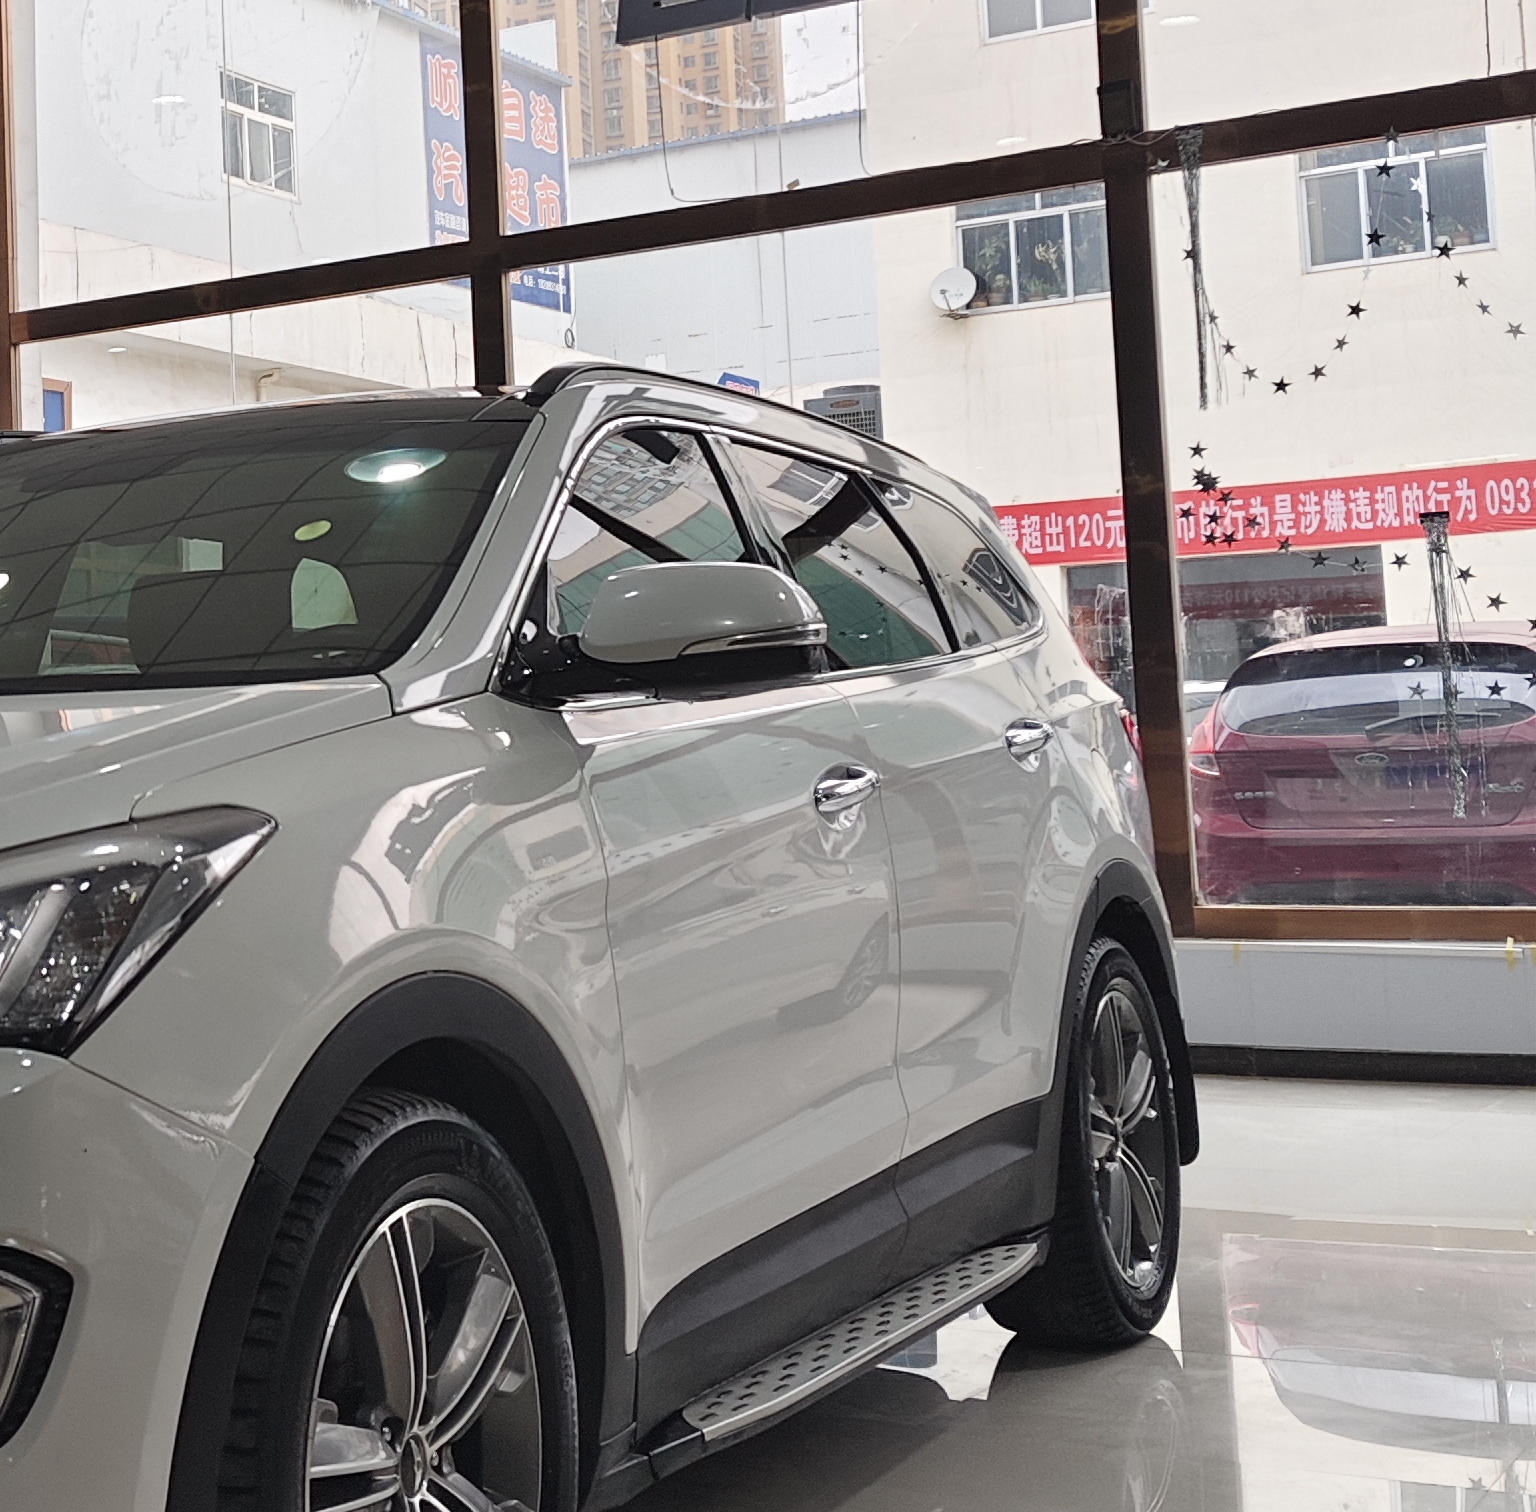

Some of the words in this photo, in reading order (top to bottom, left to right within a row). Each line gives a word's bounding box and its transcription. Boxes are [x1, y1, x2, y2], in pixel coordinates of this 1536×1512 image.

[427, 53, 560, 156] 顺自选
[431, 138, 562, 229] 汽超市
[1484, 477, 1536, 516] 093
